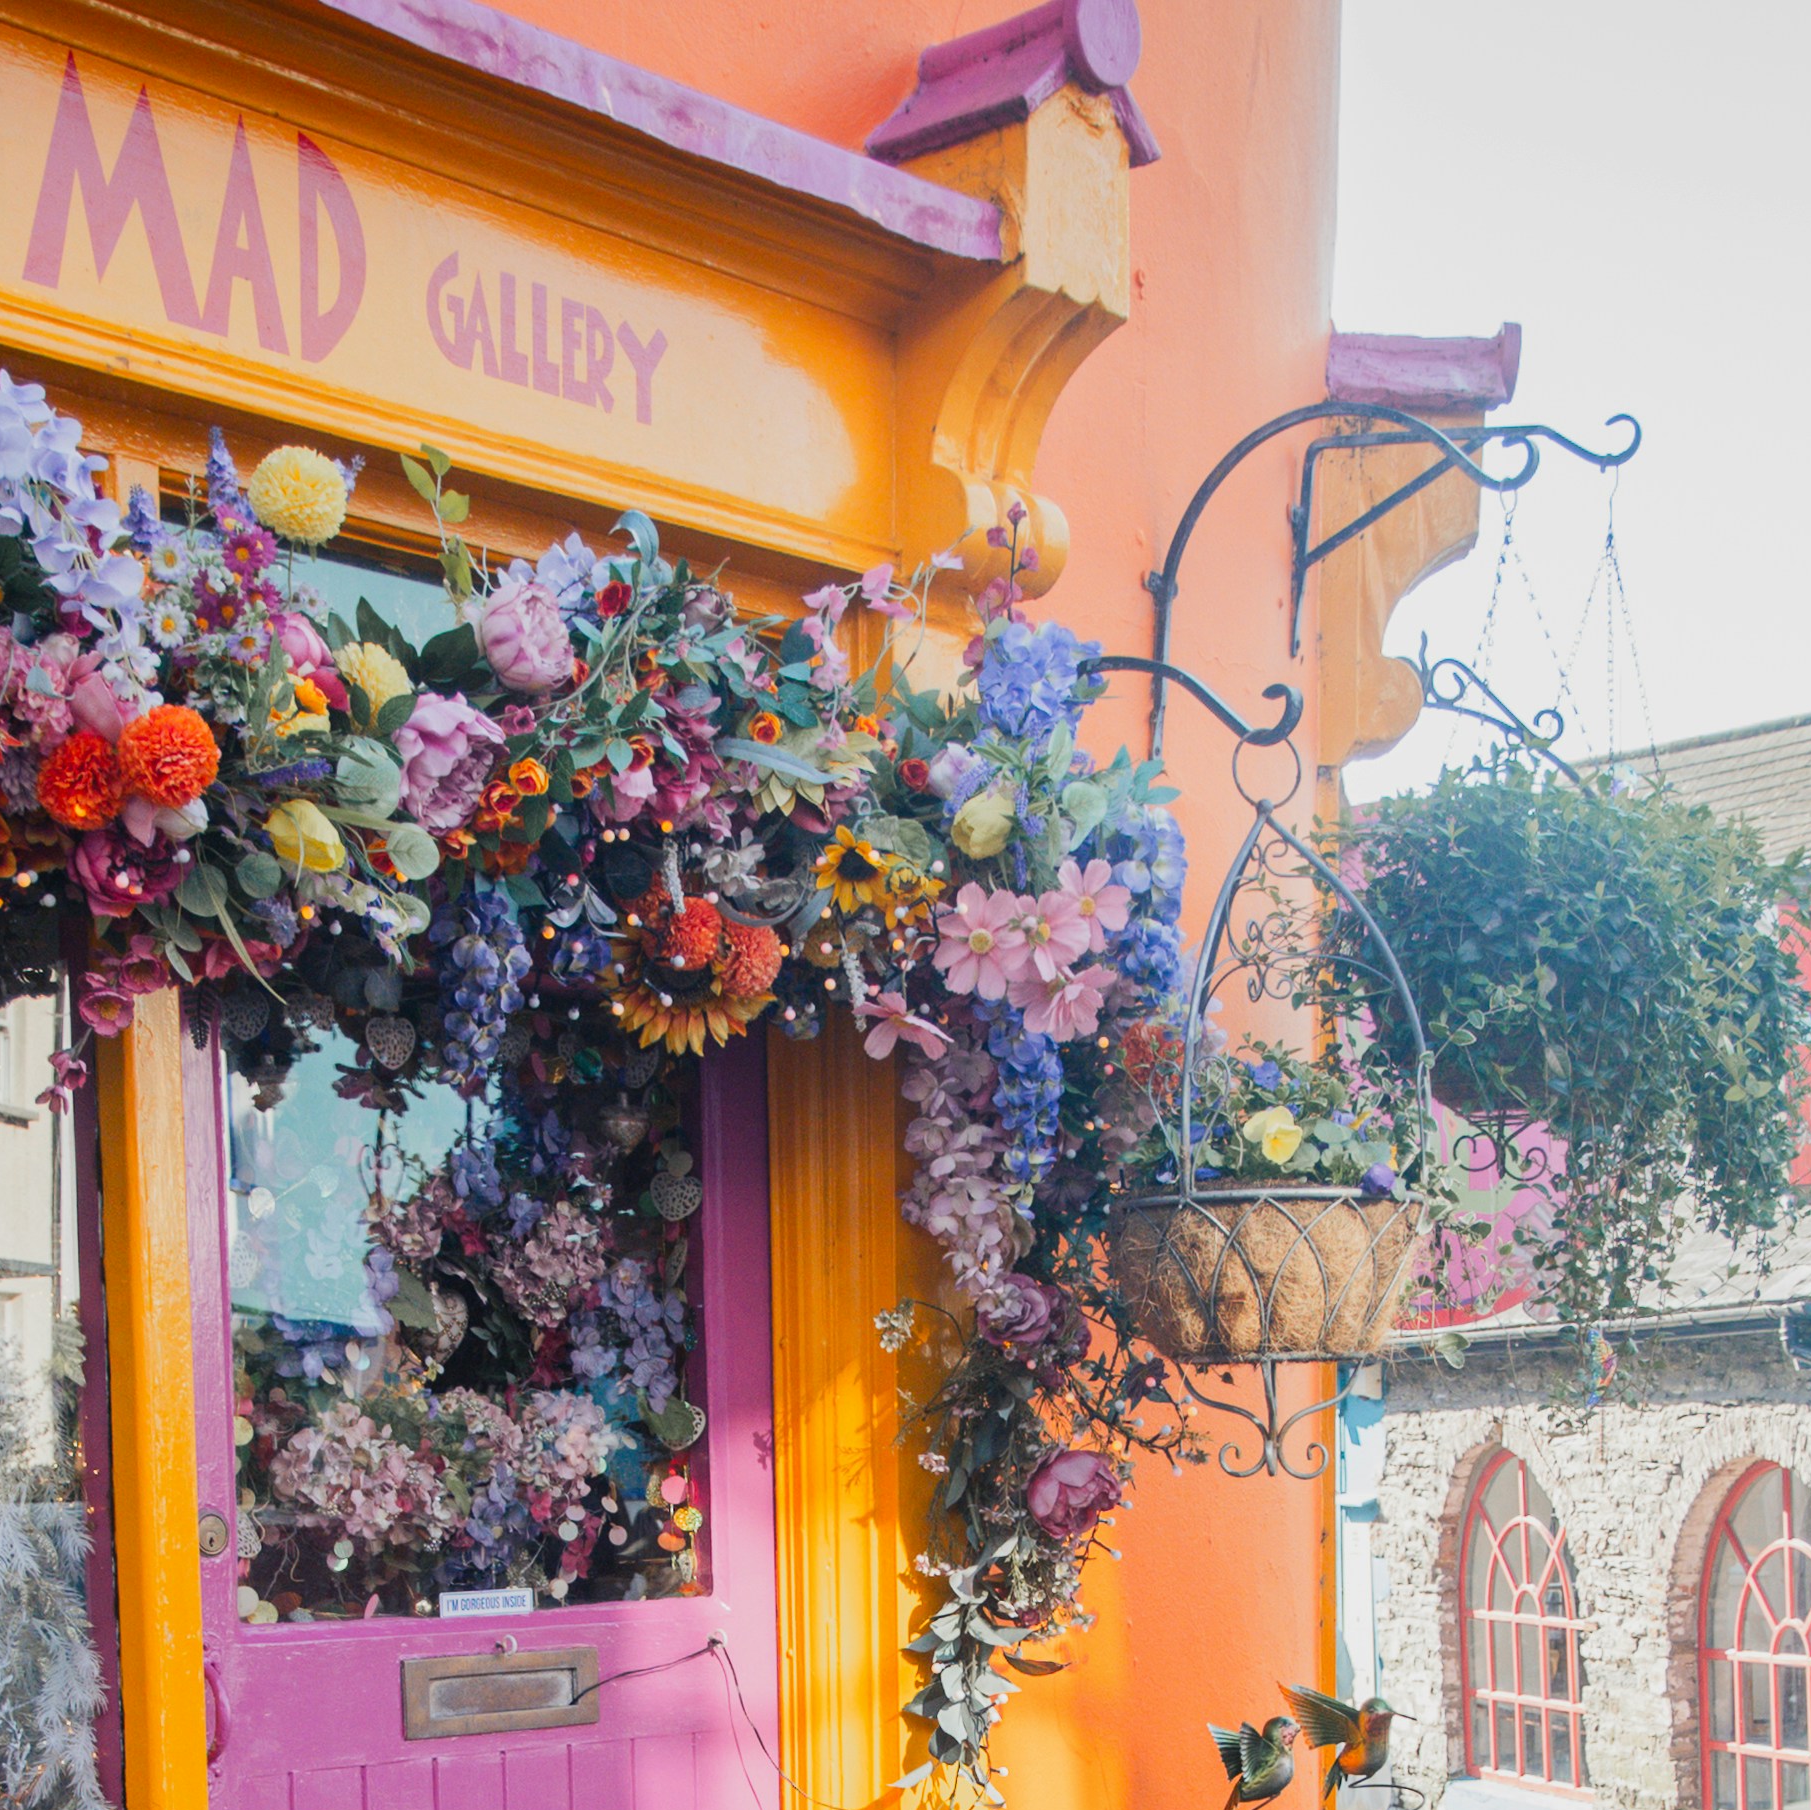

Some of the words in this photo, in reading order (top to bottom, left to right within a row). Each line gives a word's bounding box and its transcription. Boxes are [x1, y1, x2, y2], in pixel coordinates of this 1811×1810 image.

[22, 47, 367, 364] MAD
[425, 250, 669, 426] GALLERY
[446, 1599, 459, 1612] I'M
[460, 1596, 501, 1611] GORGEOUS
[502, 1594, 527, 1608] INSIDE
